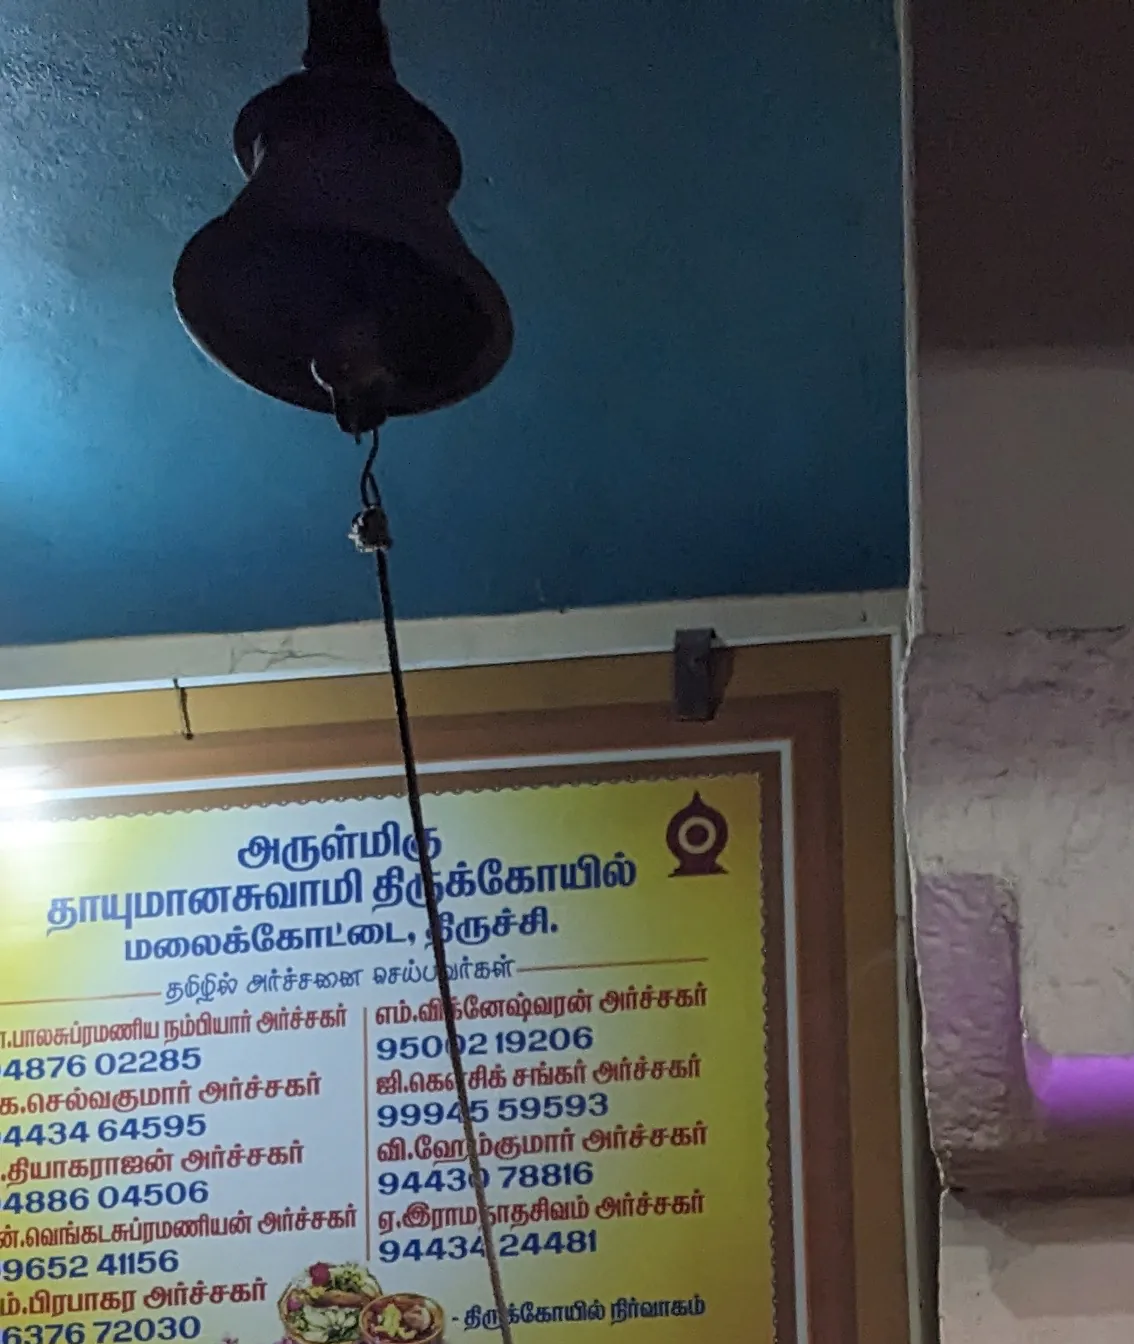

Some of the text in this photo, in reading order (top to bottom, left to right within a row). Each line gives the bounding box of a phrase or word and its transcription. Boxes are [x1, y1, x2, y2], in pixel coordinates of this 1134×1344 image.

[238, 821, 442, 872] அருள்மிகு
[46, 852, 637, 936] தாயுமானசுவாமி திருக்கோயில்
[125, 919, 416, 963] மலைக்கோட்டை,
[164, 970, 239, 1005] தமிழில்
[247, 965, 363, 993] அர்ச்சனை
[599, 981, 707, 1013] அர்ச்சகர்
[165, 1008, 251, 1044] நம்பியார்
[257, 1003, 347, 1033] அர்ச்சகர்
[377, 1026, 593, 1060] 95002 19206
[0, 1047, 201, 1082] 4876 02285
[513, 1058, 585, 1089] சங்கர்
[593, 1052, 702, 1084] அர்ச்சகர்
[199, 1071, 321, 1104] அர்ச்சகர்
[377, 1092, 608, 1127] 99945 59593
[0, 1113, 206, 1148] 4434 64595
[582, 1120, 707, 1151] அர்ச்சகர்
[181, 1140, 303, 1173] அர்ச்சகர்
[378, 1161, 593, 1195] 94430 78816
[0, 1180, 209, 1215] 4886 04506
[596, 1188, 705, 1220] அர்ச்சகர்
[258, 1203, 356, 1233] அர்ச்சகர்
[379, 1229, 597, 1263] 94434 24481
[0, 1249, 179, 1282] 9652 41156
[144, 1277, 267, 1309] அர்ச்சகர்
[464, 1294, 705, 1329] திருக்கோயில் நிர்வாகம்
[93, 1316, 201, 1344] 72030
